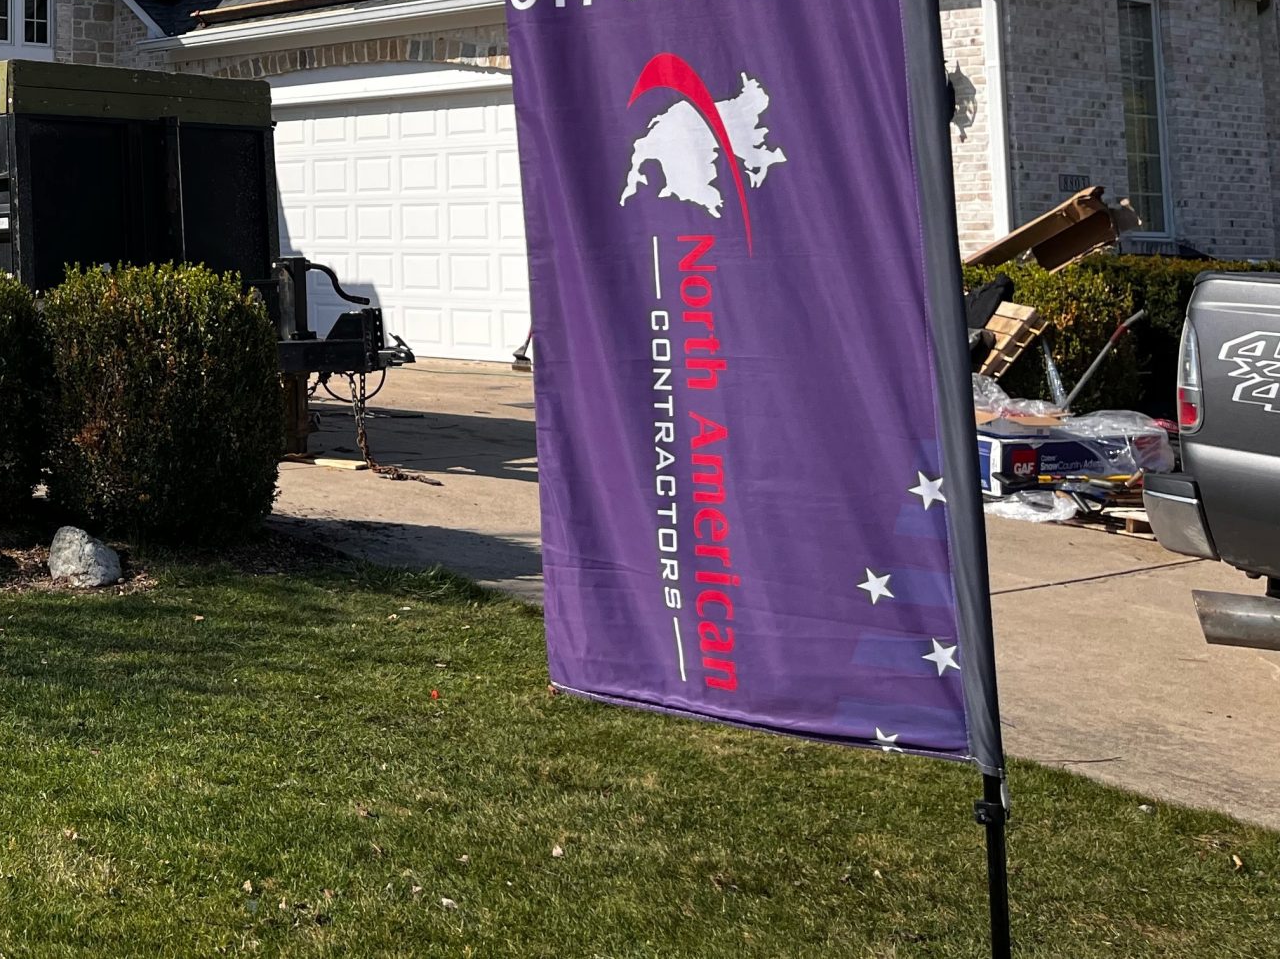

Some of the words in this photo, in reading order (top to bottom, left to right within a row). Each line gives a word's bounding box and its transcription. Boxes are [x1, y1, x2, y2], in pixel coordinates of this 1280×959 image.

[676, 234, 726, 391] North
[651, 310, 682, 609] CONTRACTORS
[687, 410, 741, 692] American
[1014, 462, 1036, 475] GAF
